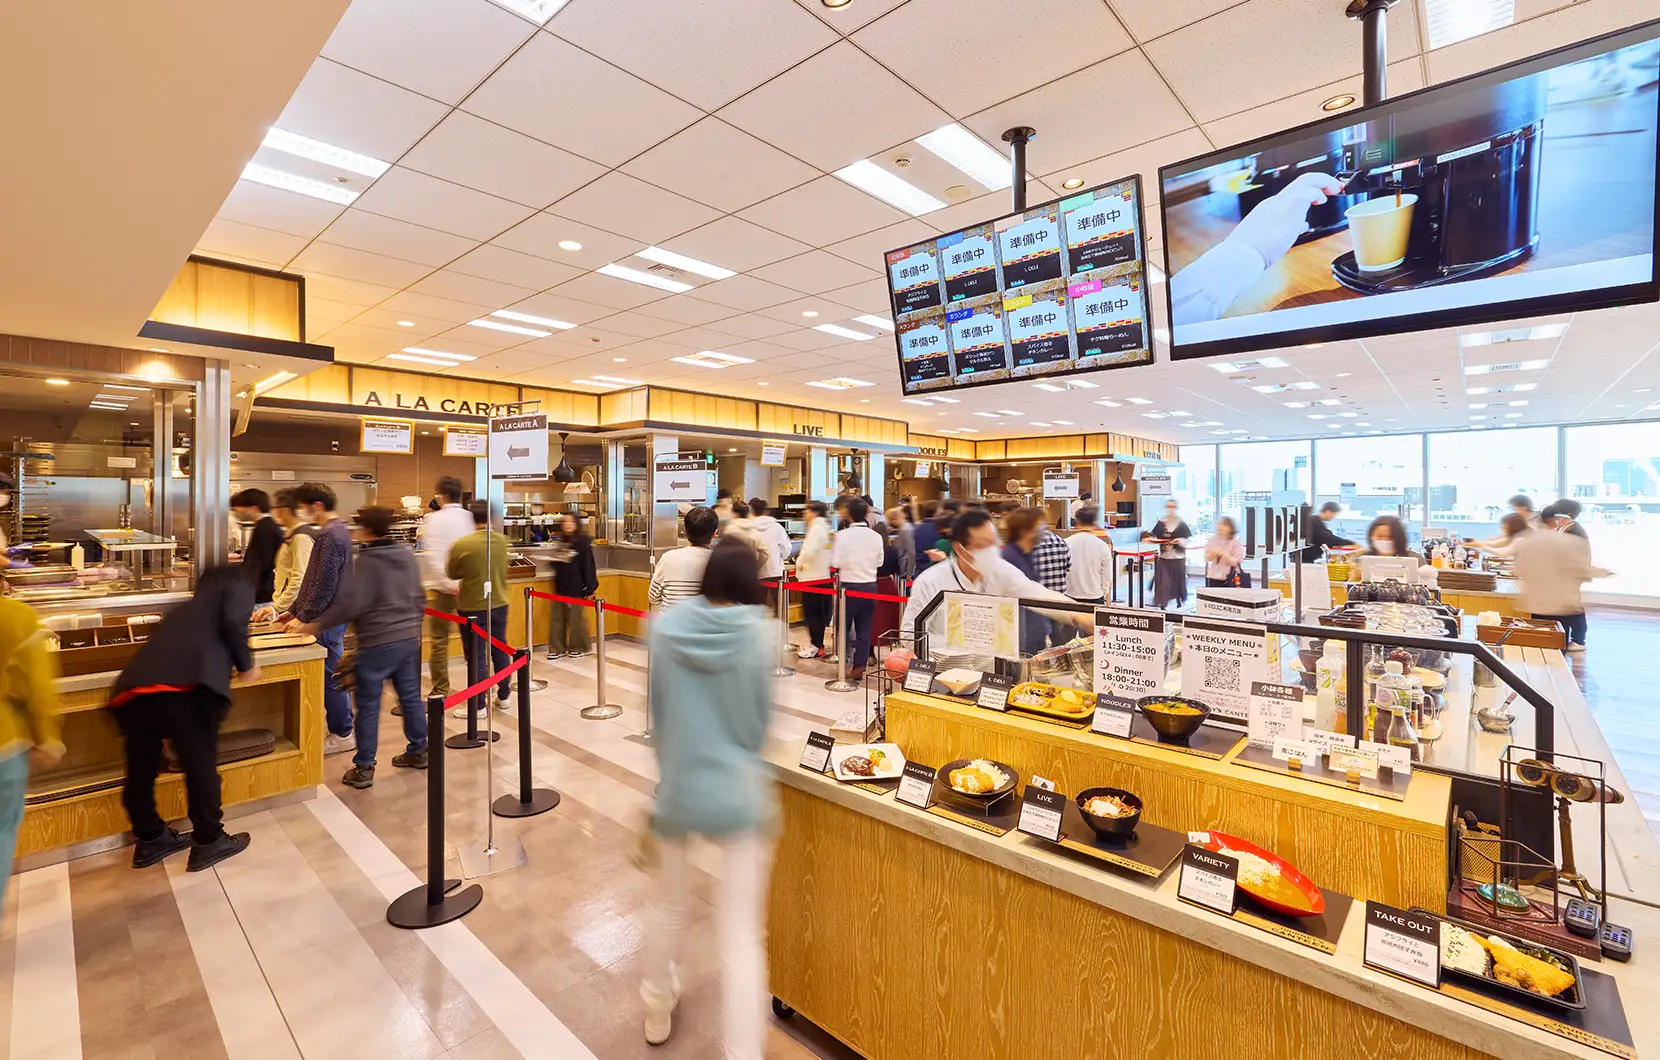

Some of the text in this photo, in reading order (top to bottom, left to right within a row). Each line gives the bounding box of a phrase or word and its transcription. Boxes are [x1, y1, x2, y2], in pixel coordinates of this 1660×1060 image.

[1077, 209, 1121, 231] 準備中
[1010, 230, 1048, 249] 準備中
[952, 248, 985, 265] 準備中
[900, 263, 930, 279] 準備中
[1085, 298, 1129, 316] 準備中
[1019, 312, 1057, 328] 準備中
[961, 324, 994, 339] 準備中
[909, 335, 939, 349] 準備中
[365, 391, 522, 418] A LA CARTE
[512, 421, 532, 429] CARTE
[532, 419, 539, 428] A
[793, 424, 823, 437] LIVE
[914, 446, 949, 456] OODLES
[1108, 614, 1150, 629] 営業時間
[1115, 634, 1143, 645] Lunch
[1191, 633, 1256, 649] WEEKLY MENU
[1102, 641, 1157, 656] 11:30-15:00
[1114, 665, 1144, 677] Dinner
[1102, 673, 1157, 689] 18:00-21:00
[1101, 698, 1132, 708] NOODLES
[1036, 793, 1053, 803] LIVE
[1192, 852, 1230, 870] VARIETY
[1374, 909, 1433, 935] TAKE OUT
[1383, 931, 1420, 949] アジフライと
[1543, 1022, 1632, 1057] CANTEEN
